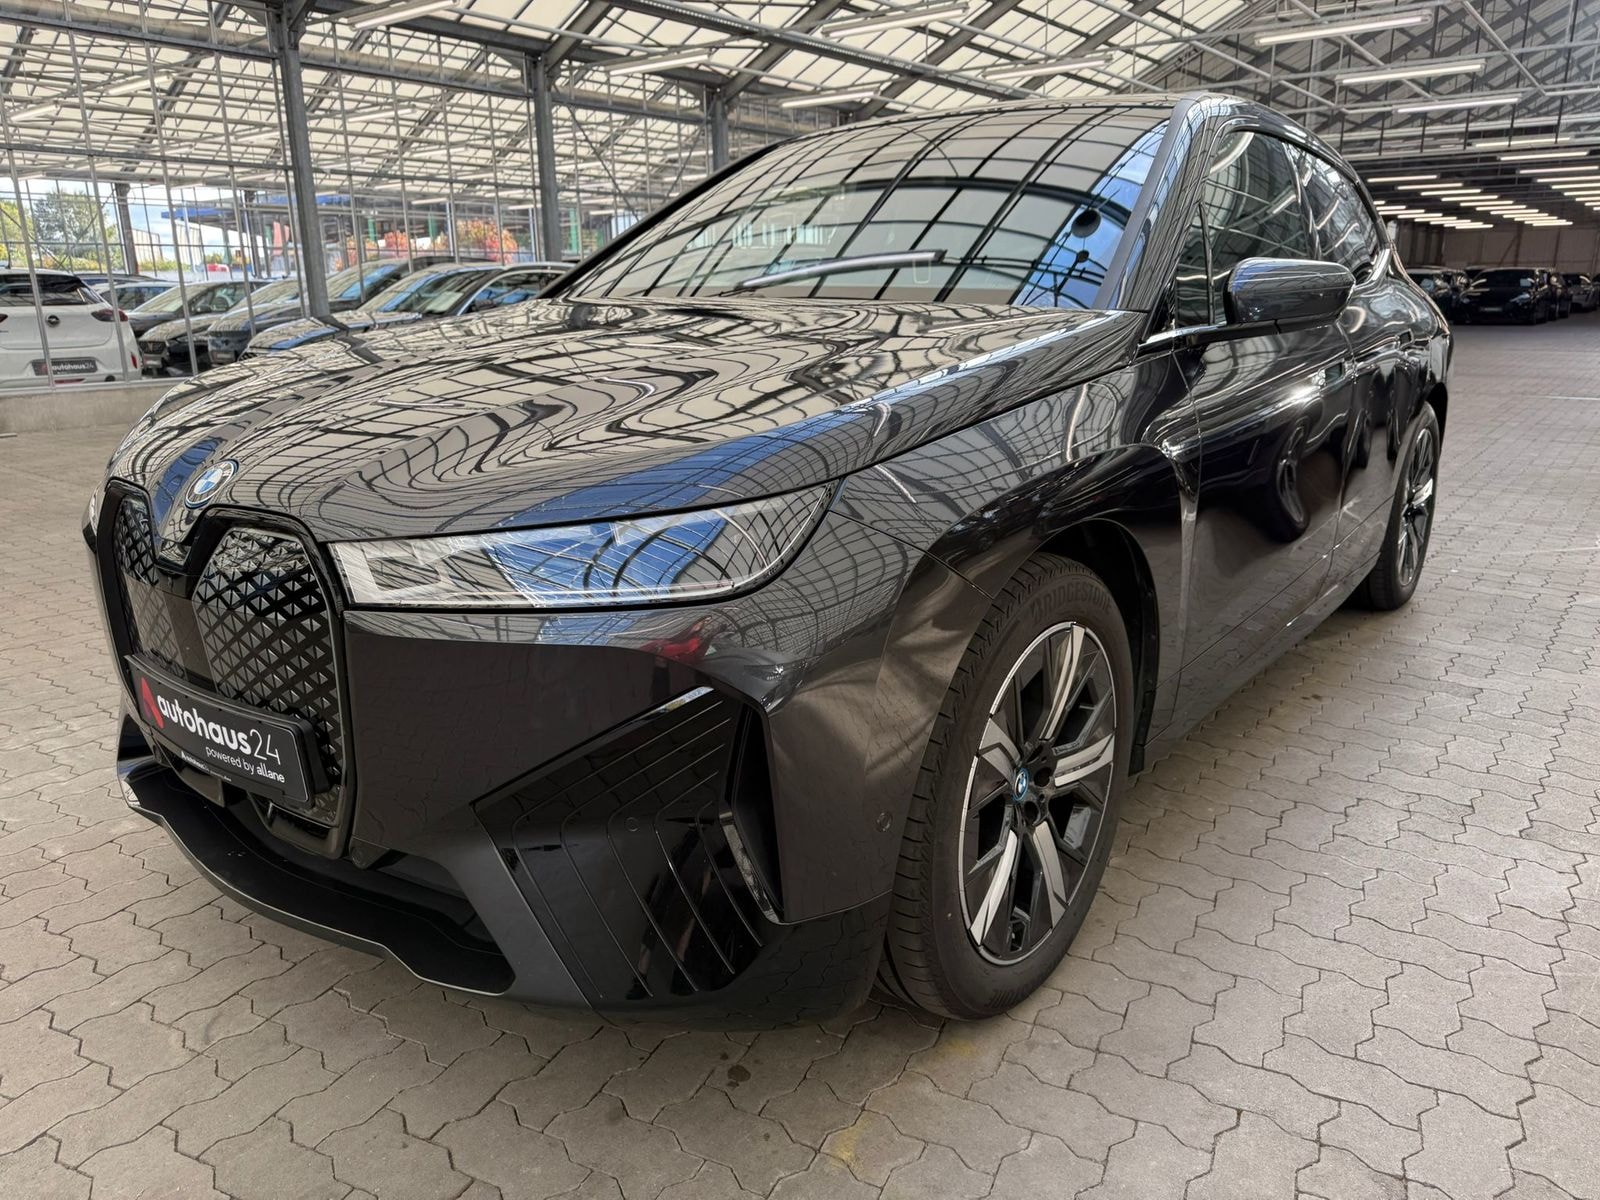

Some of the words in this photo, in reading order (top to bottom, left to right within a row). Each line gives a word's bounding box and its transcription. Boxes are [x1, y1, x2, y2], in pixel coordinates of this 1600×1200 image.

[51, 362, 94, 371] autohaus24
[157, 694, 281, 765] autohaus24
[205, 746, 241, 768] powered
[243, 759, 255, 775] by
[256, 762, 285, 783] allane
